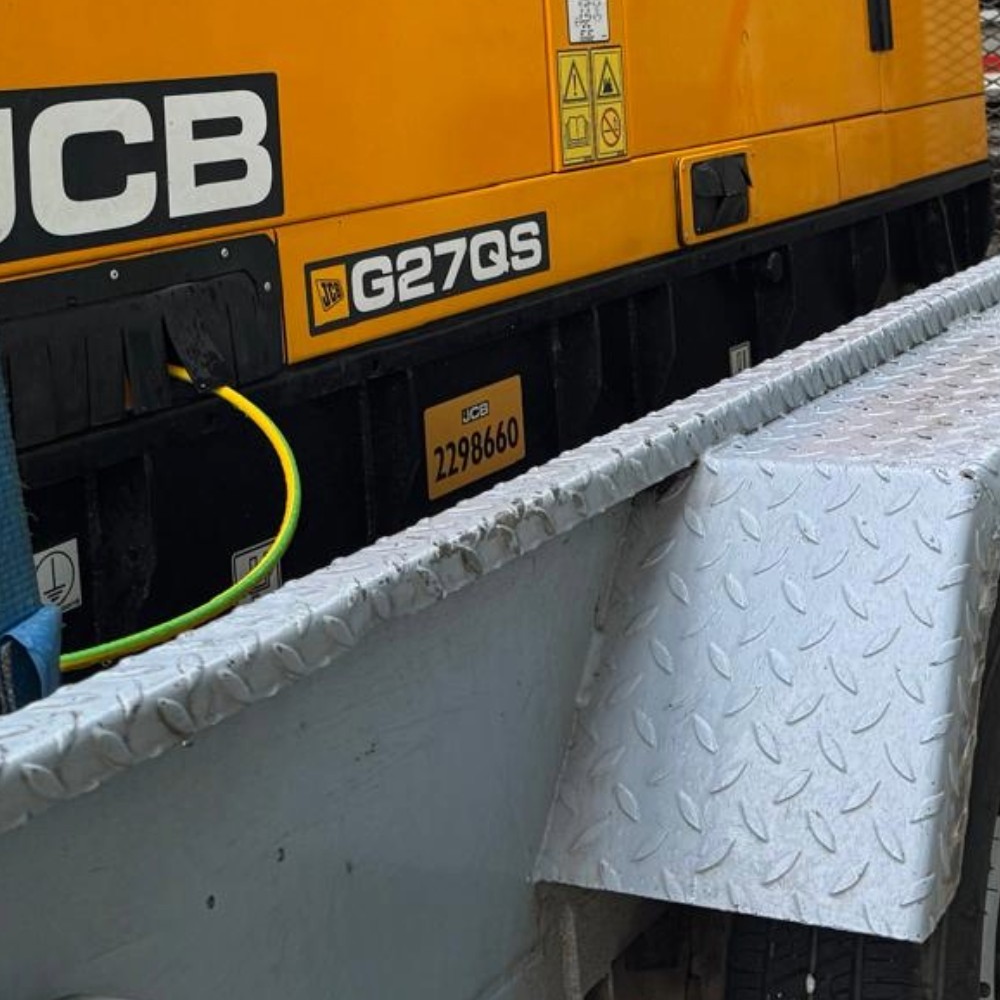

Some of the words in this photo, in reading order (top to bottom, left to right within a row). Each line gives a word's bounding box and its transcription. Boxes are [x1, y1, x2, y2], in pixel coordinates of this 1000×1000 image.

[0, 89, 273, 245] CB
[321, 282, 342, 307] JCB
[351, 220, 543, 314] G27QS
[434, 416, 519, 481] 2298660
[462, 402, 489, 423] JCB
